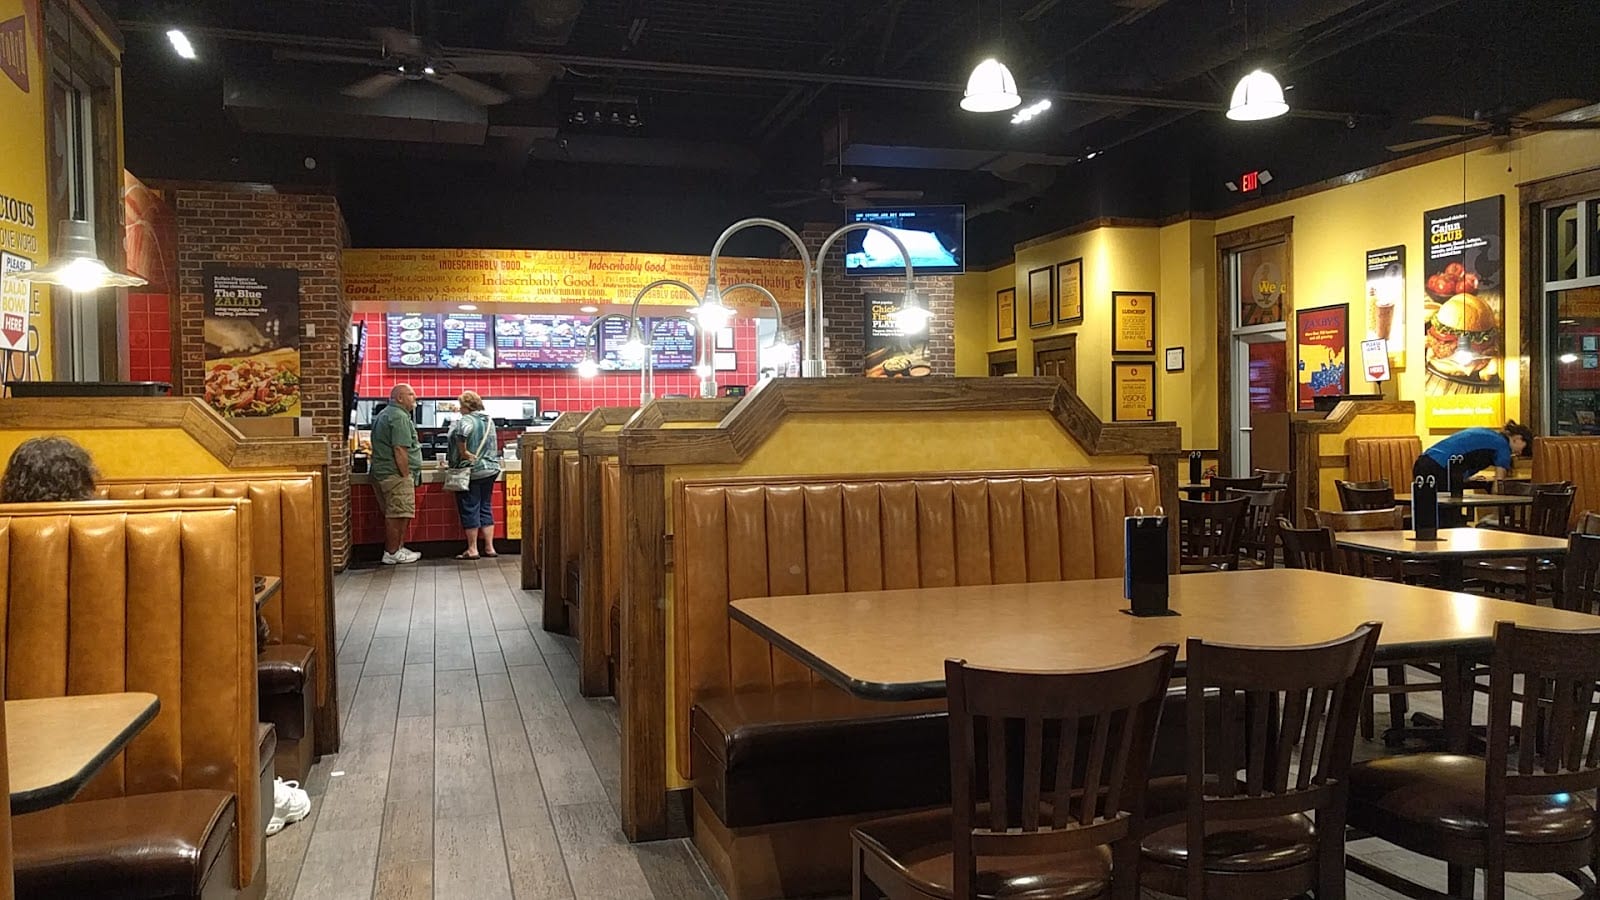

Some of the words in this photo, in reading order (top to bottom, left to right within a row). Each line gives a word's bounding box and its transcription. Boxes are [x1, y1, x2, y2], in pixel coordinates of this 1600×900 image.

[1242, 172, 1258, 192] EXIT
[1431, 222, 1460, 235] Cajun
[17, 230, 37, 253] WORD
[1431, 229, 1463, 244] CLUB
[439, 260, 498, 271] INDESCRIBABLY
[481, 273, 561, 287] Indescribably
[563, 274, 599, 287] Good.
[3, 280, 27, 296] ZALAD
[214, 289, 236, 298] The
[237, 290, 262, 298] Blue
[345, 284, 381, 294] Good.
[3, 297, 27, 313] BOWL
[215, 298, 262, 306] ZALAD
[5, 316, 23, 332] HERE
